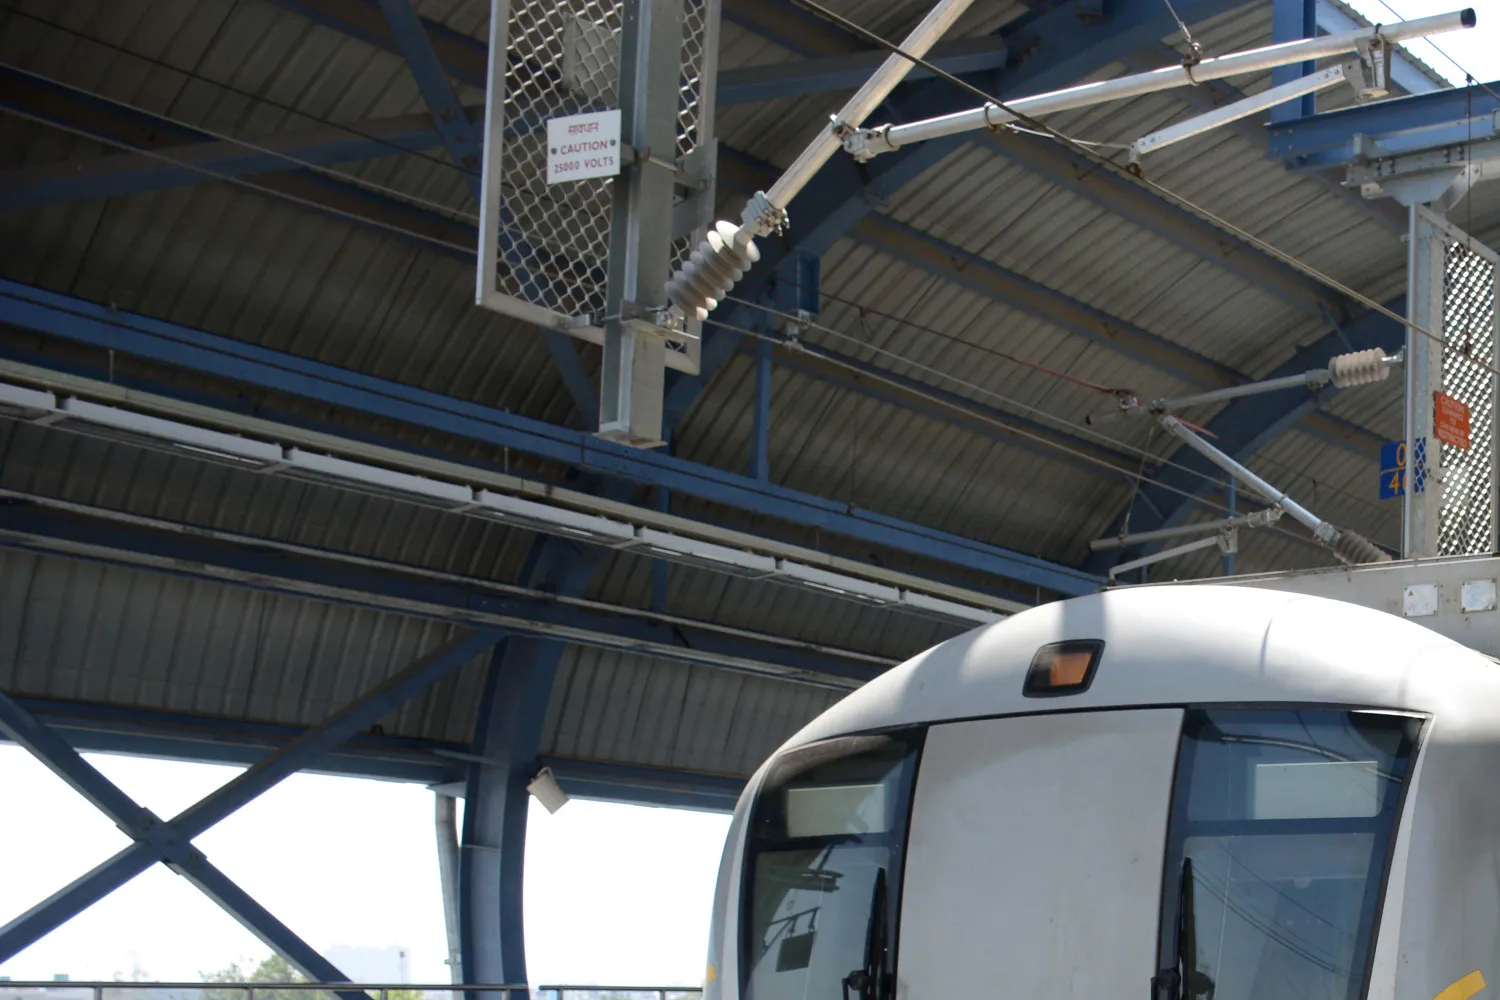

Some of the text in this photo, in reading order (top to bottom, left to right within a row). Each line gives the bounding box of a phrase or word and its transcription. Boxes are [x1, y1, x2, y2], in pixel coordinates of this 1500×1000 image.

[560, 140, 608, 155] CAUTION
[554, 156, 615, 175] 25000 VOLTS
